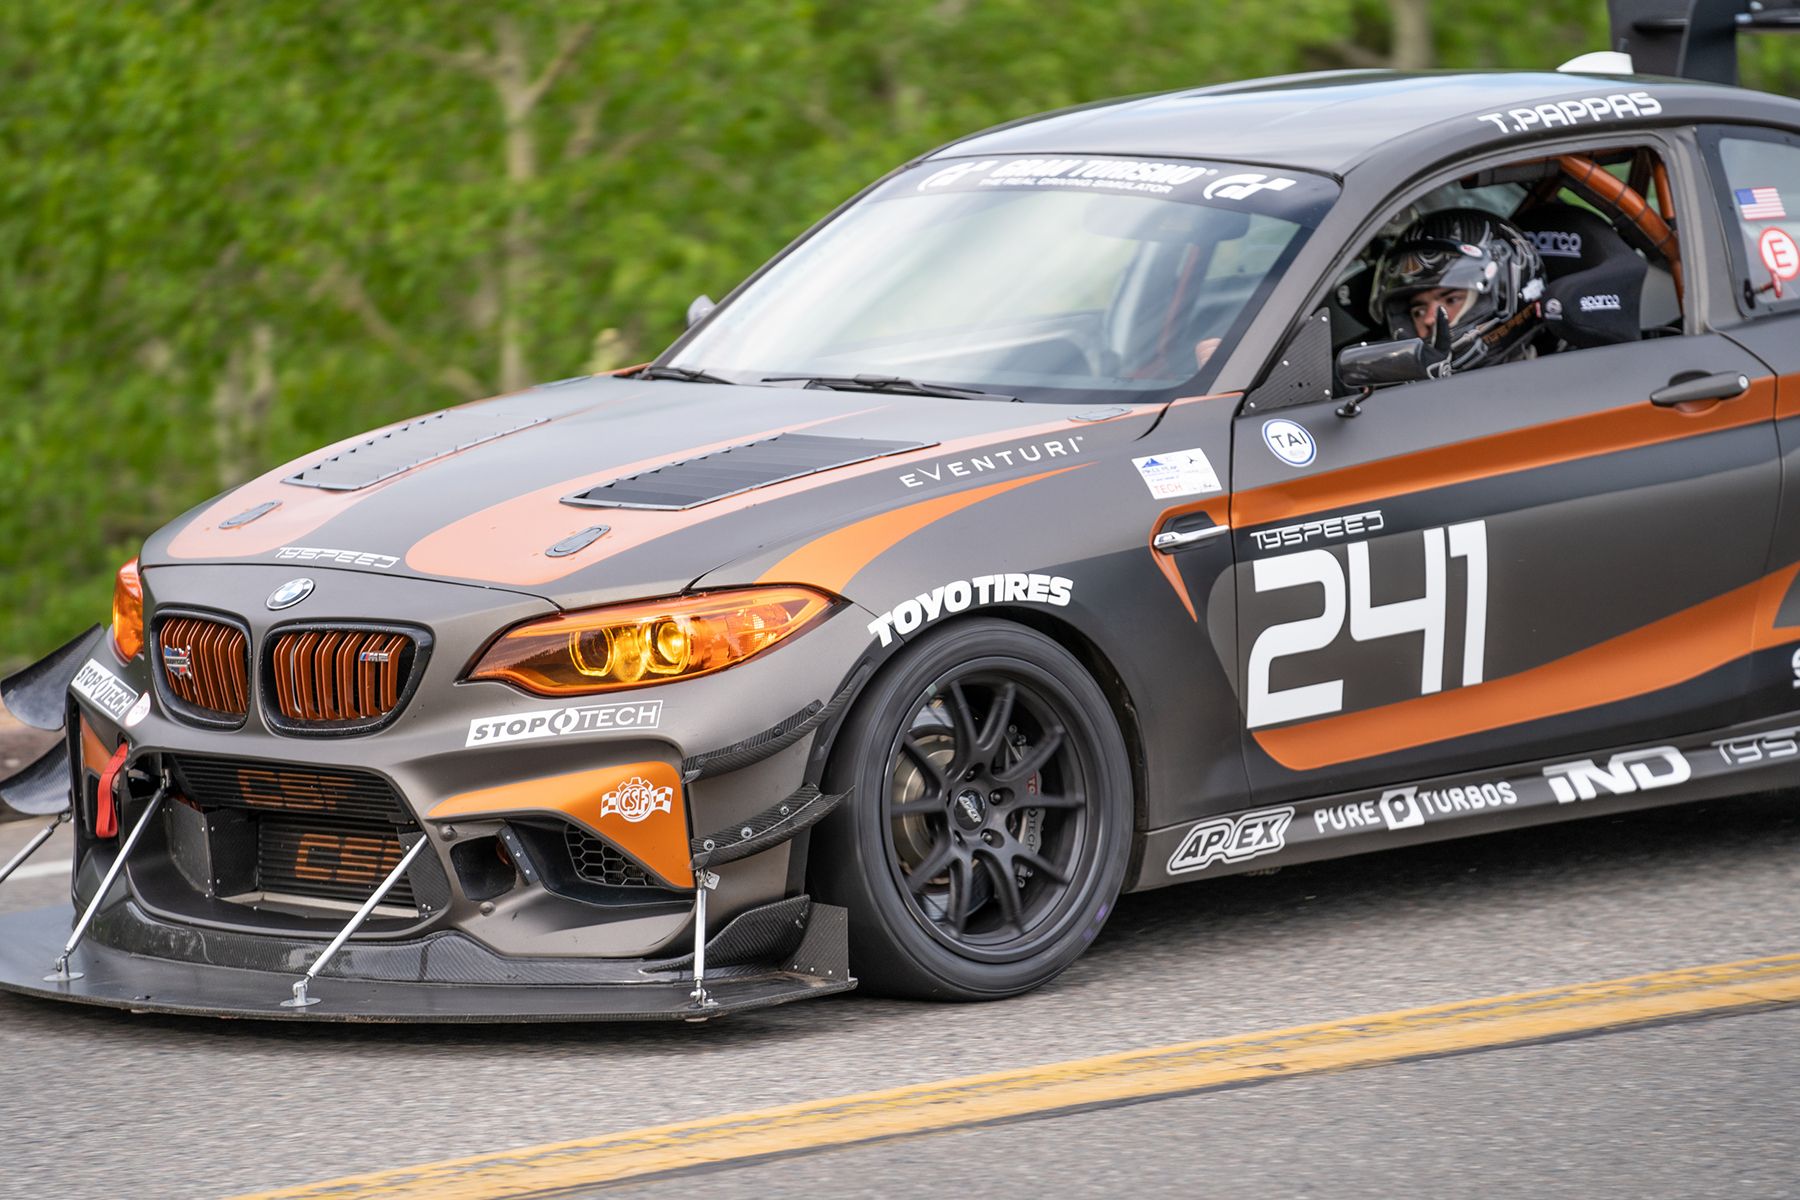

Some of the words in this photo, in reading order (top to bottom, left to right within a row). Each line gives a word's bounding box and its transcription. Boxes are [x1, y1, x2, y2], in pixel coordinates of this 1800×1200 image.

[1477, 91, 1663, 134] T.PAPPAS
[1768, 239, 1793, 269] E
[898, 437, 1081, 488] EVENTURI
[1270, 431, 1307, 449] TAI
[866, 579, 973, 648] TOYO
[971, 572, 1074, 607] TIRES
[1246, 519, 1489, 730] 241
[619, 787, 650, 815] CSF
[1313, 800, 1381, 833] PURE
[1420, 781, 1518, 815] TURBOS
[1177, 814, 1283, 863] APEX
